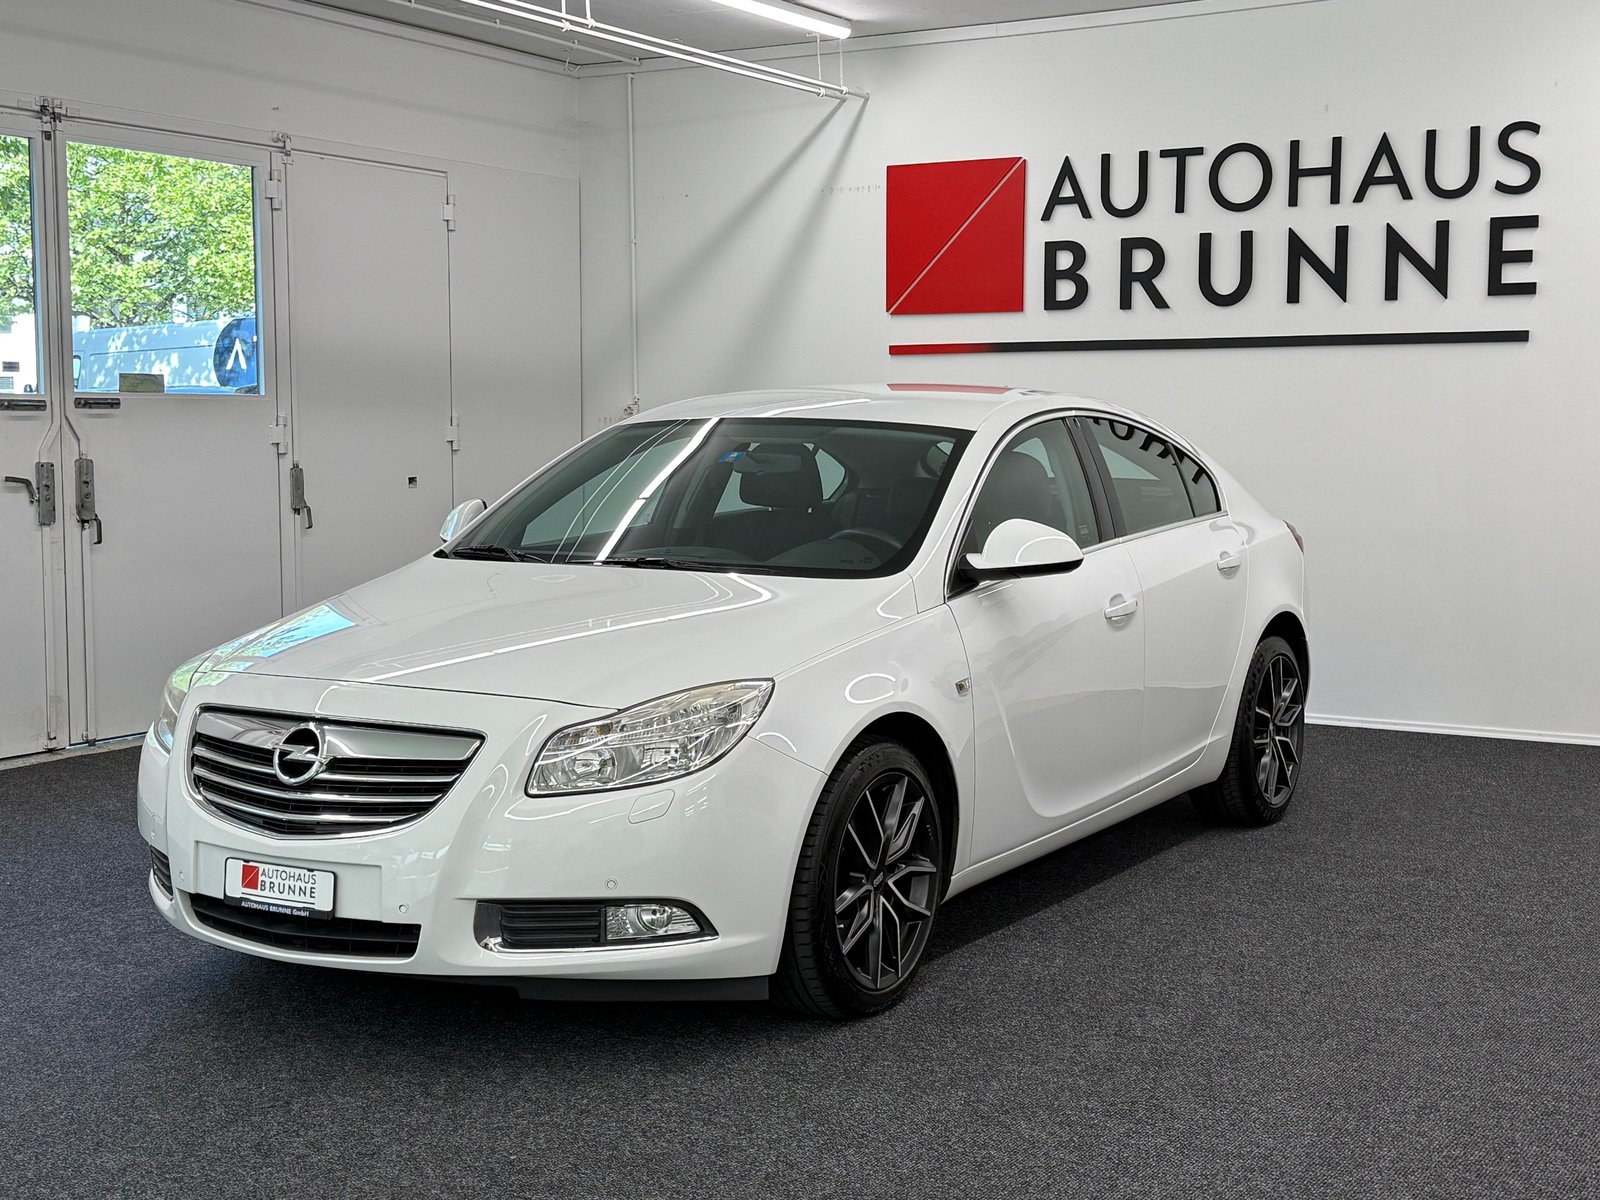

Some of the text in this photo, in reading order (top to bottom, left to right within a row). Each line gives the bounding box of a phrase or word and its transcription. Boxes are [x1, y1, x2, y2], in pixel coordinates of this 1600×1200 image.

[1041, 121, 1541, 221] AUTOHAUS
[1043, 214, 1539, 311] BRUNNE
[260, 867, 317, 885] AUTOHAUS
[260, 880, 316, 899] BRUNNE
[241, 900, 310, 917] AUTOHAUS BRUNNE GmbH
